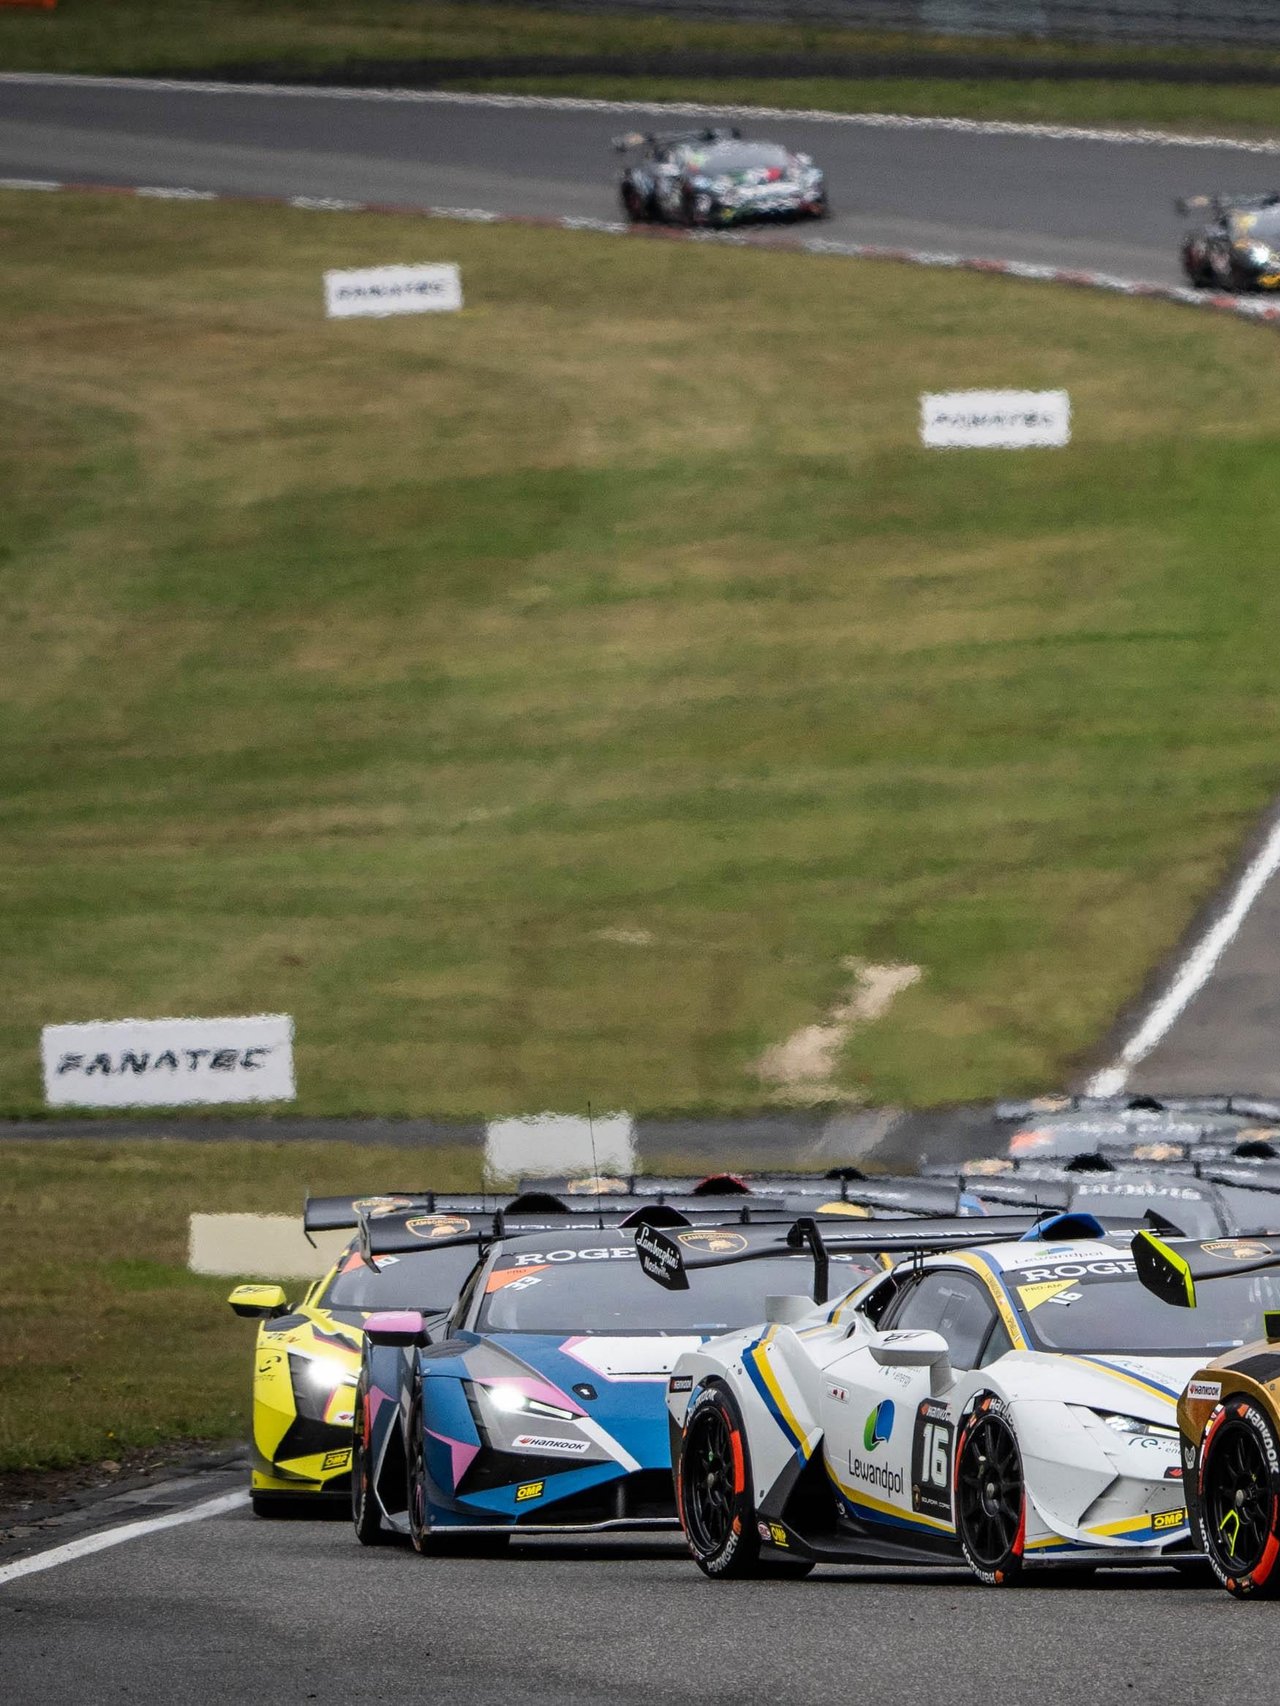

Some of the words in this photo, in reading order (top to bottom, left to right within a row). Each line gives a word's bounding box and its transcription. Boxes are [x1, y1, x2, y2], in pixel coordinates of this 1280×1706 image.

[57, 1047, 272, 1077] FANATEC
[515, 1247, 637, 1266] ROGE
[636, 1227, 680, 1270] Lamborghini
[1020, 1261, 1138, 1282] ROGE
[921, 1422, 949, 1488] 16
[848, 1448, 905, 1498] Lewandpol
[517, 1484, 543, 1498] OMP
[1154, 1512, 1184, 1527] OMP
